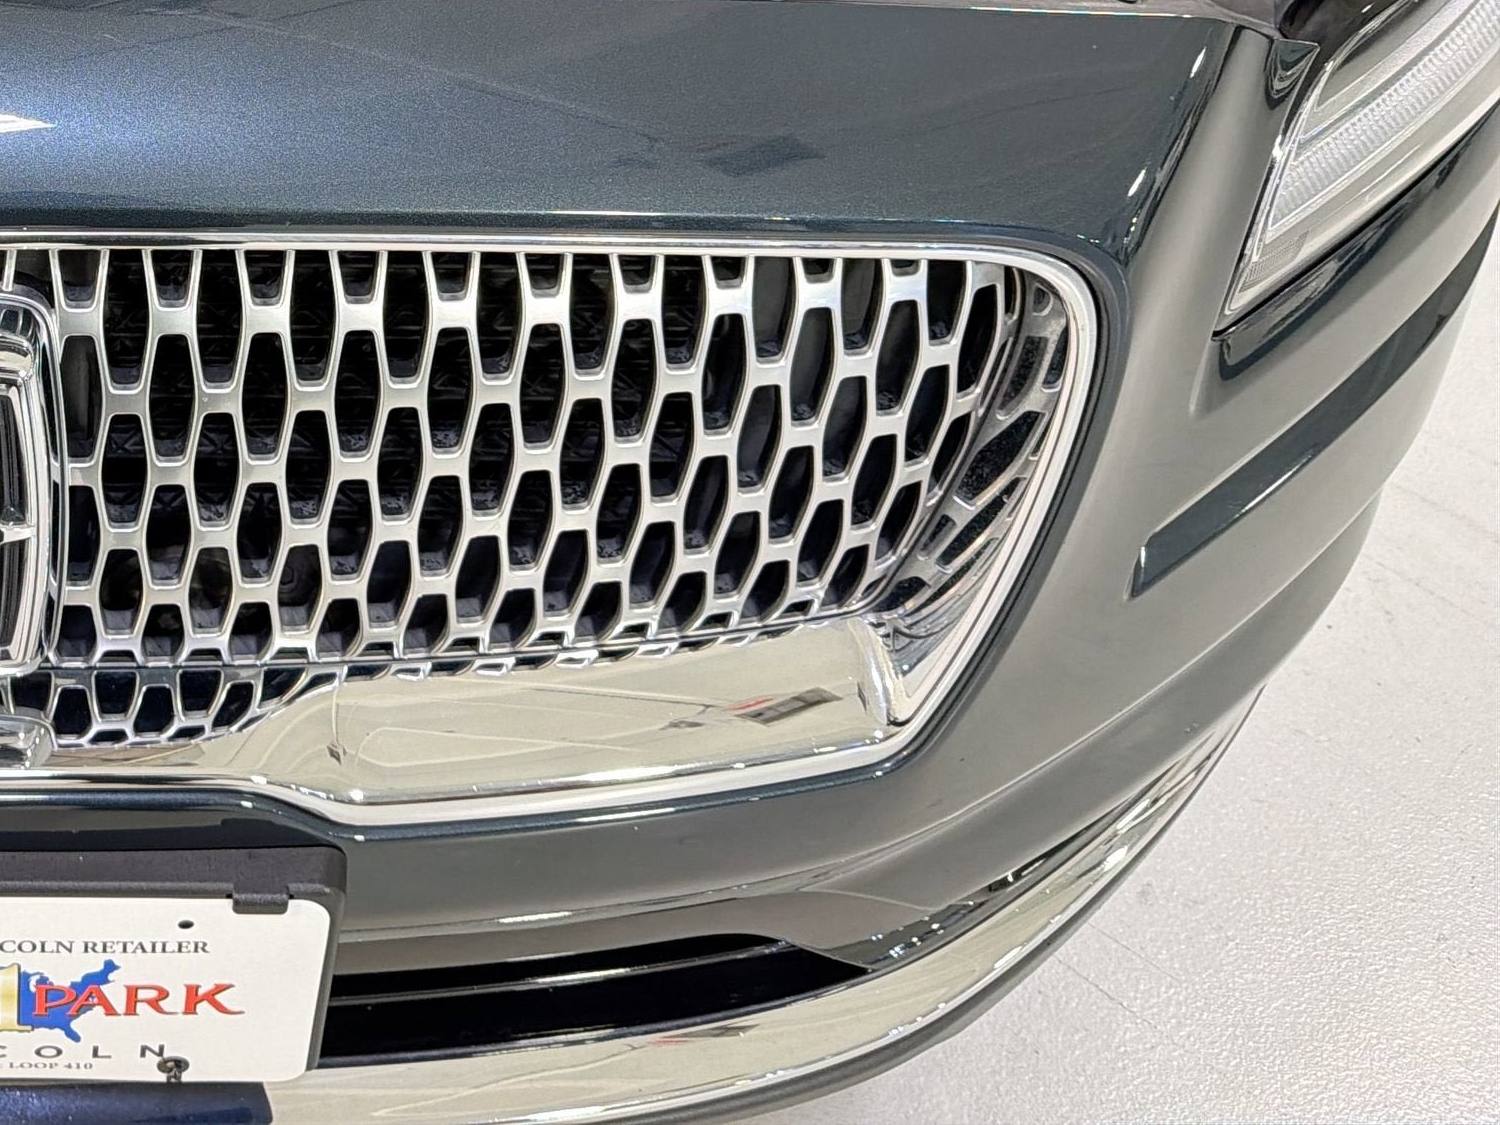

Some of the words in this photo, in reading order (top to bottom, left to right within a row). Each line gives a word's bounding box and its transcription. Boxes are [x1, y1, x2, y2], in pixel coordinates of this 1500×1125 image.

[82, 940, 210, 954] RETAILER
[32, 983, 246, 1017] PARK
[9, 1062, 58, 1070] LOOP
[63, 1062, 93, 1070] 410
